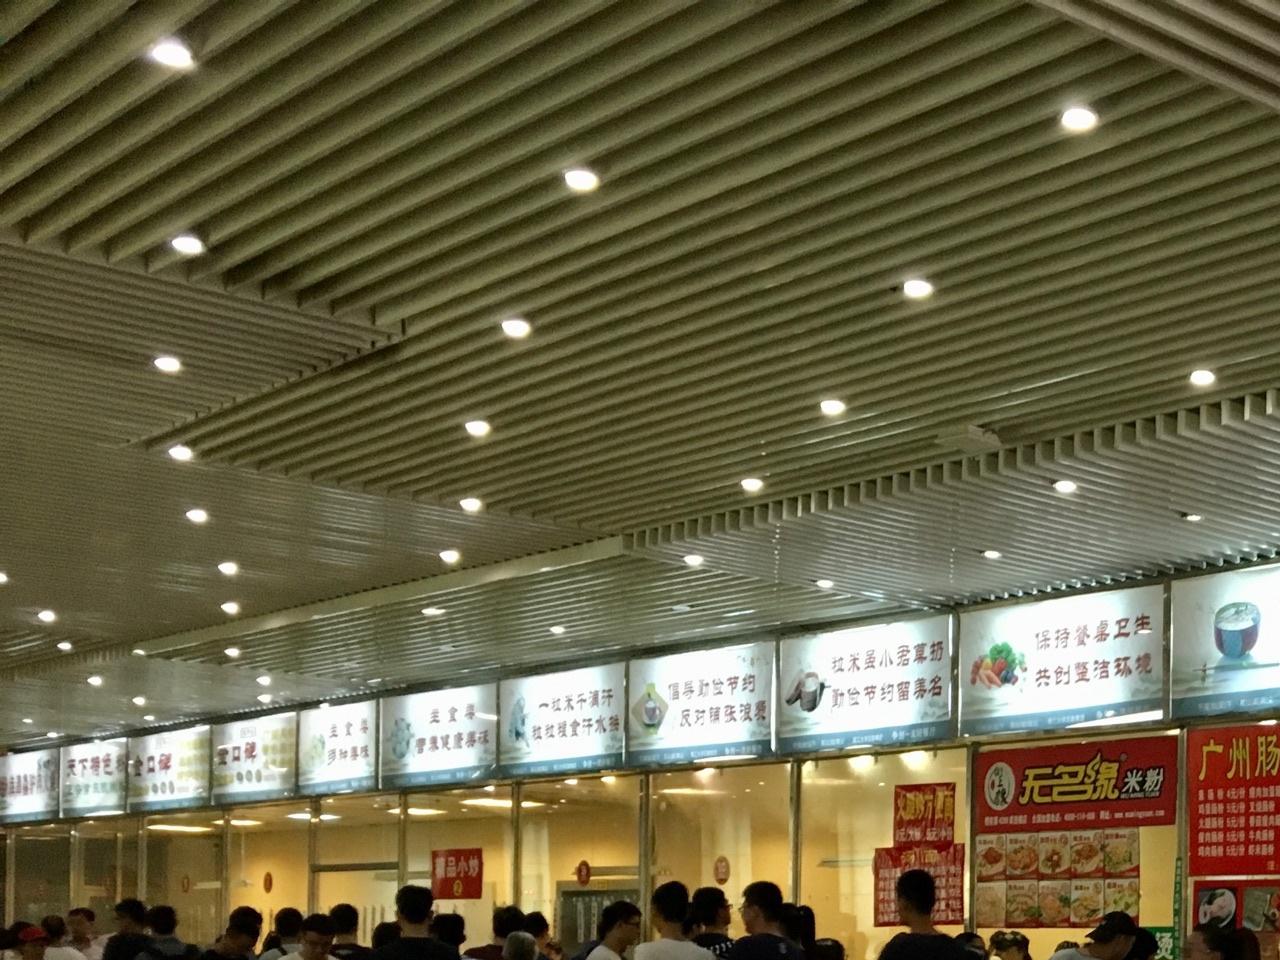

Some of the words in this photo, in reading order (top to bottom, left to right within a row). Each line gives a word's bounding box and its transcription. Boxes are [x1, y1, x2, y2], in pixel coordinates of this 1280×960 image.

[1035, 613, 1153, 651] 保持餐桌卫生
[1035, 652, 1153, 689] 共创整洁环境
[538, 688, 614, 713] 一粒米千滴汗
[668, 673, 756, 701] 倡导勤俭节约
[831, 677, 944, 709] 勤俭节约留美名
[680, 701, 768, 728] 反对铺张浪费
[1019, 752, 1120, 804] 无名缘
[1121, 767, 1164, 794] 米粉
[435, 856, 479, 879] 精品小炒
